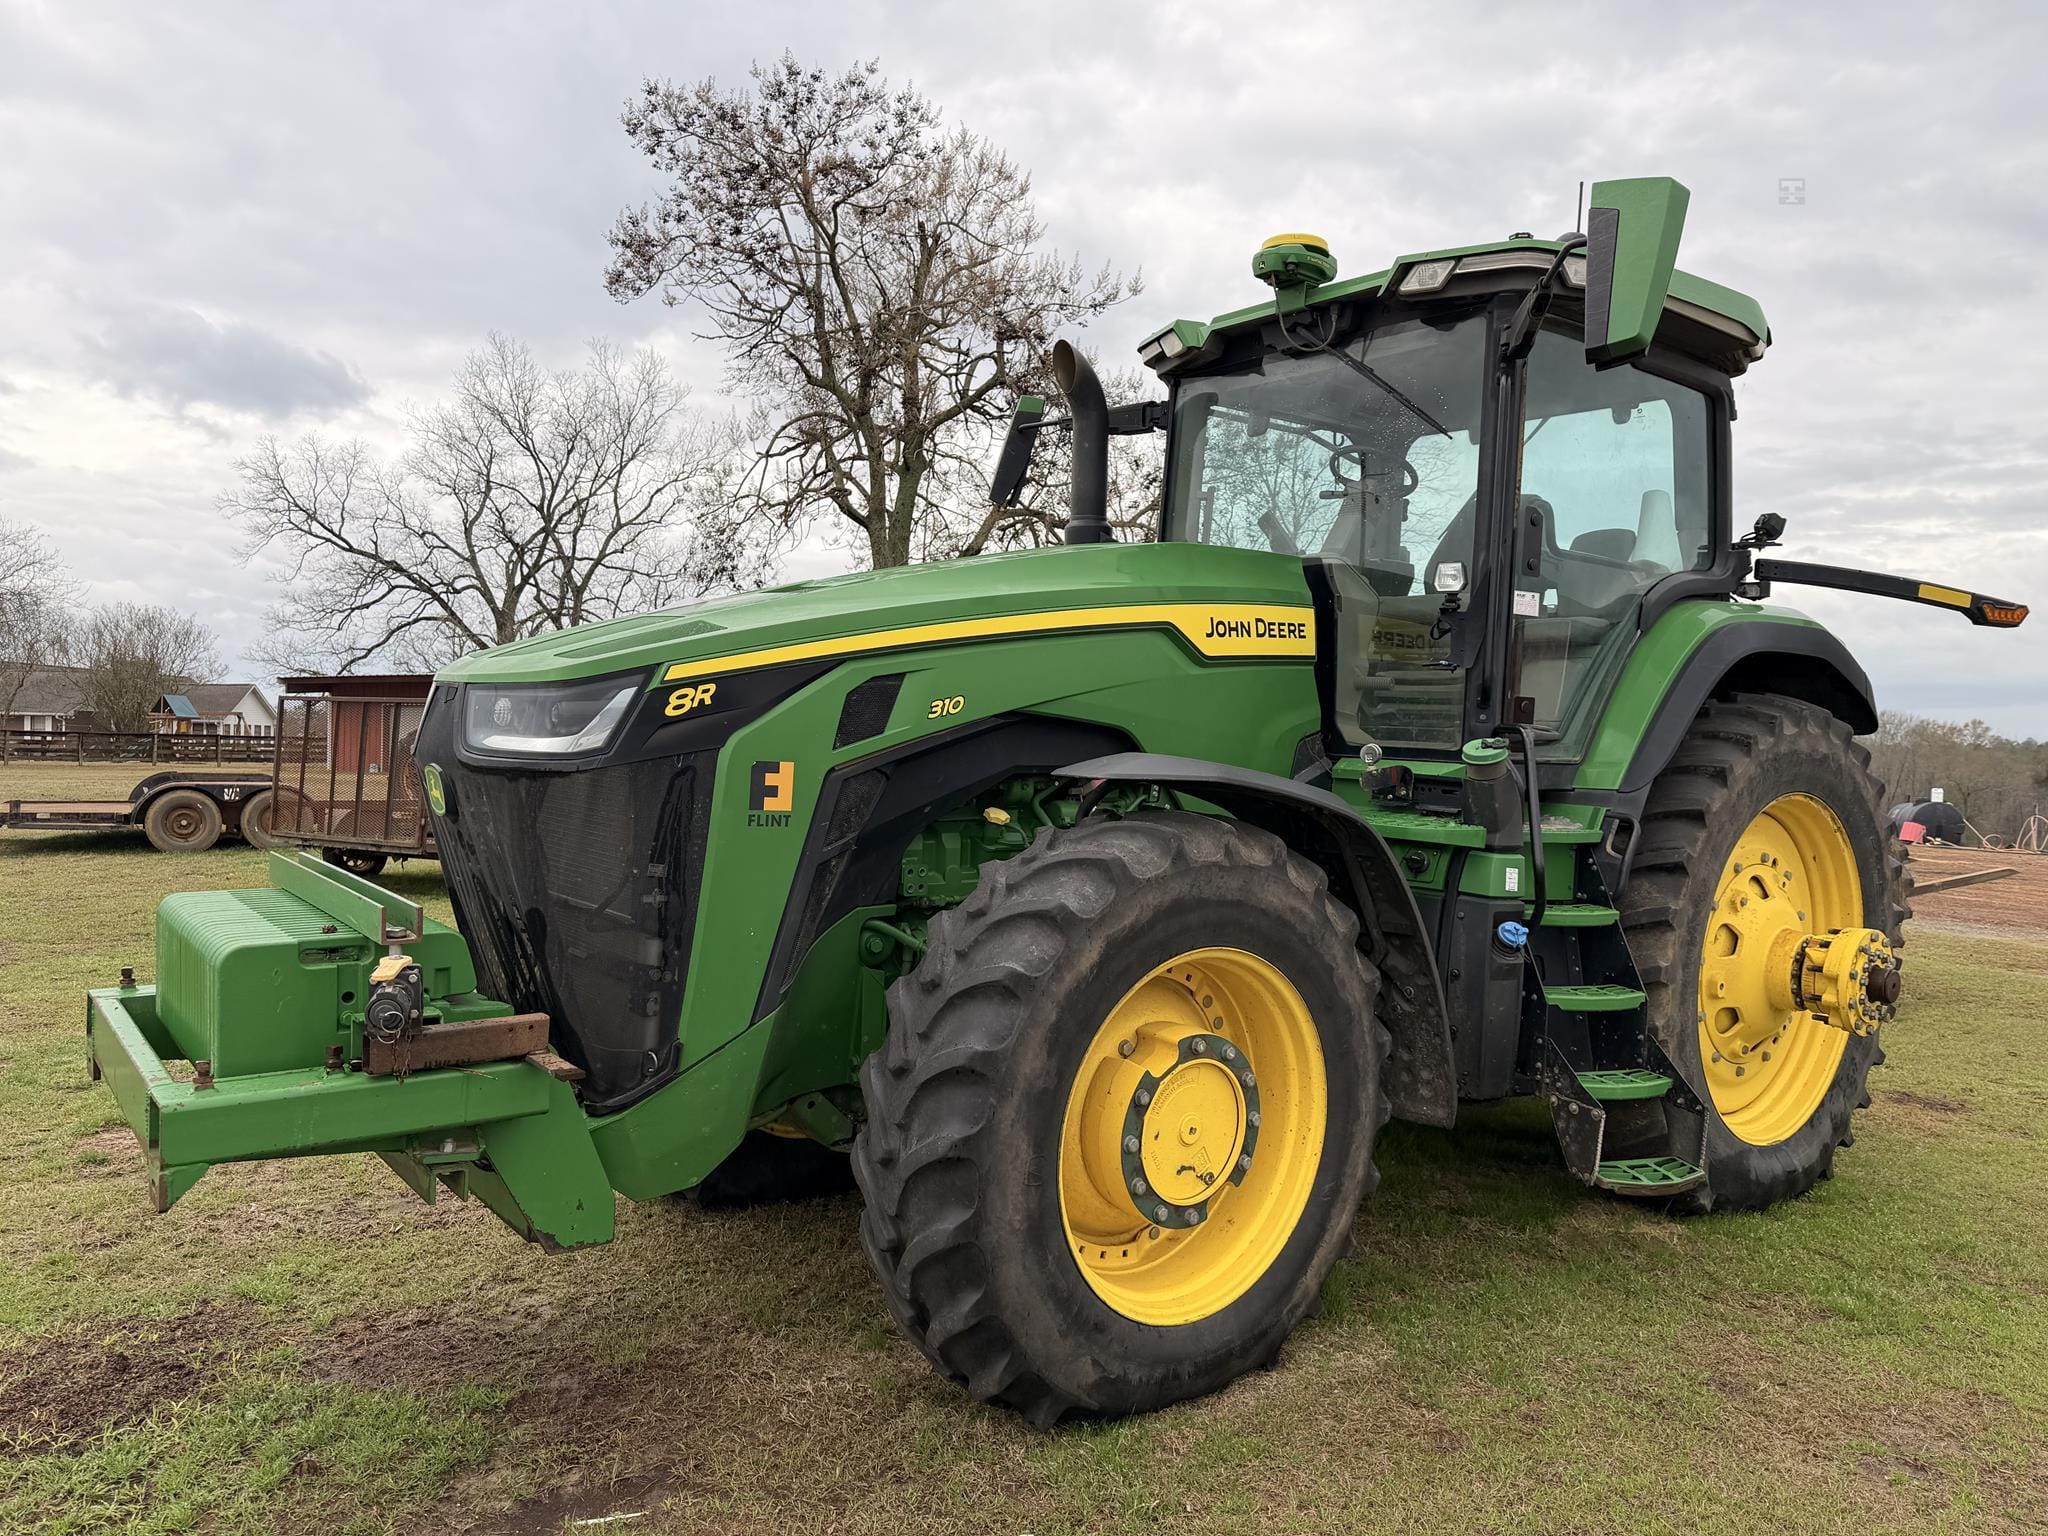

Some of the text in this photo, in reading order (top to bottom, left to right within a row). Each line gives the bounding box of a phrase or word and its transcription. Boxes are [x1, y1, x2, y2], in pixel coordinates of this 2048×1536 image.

[1206, 616, 1307, 639] JOHN DEERE
[664, 683, 717, 717] 8R
[928, 695, 965, 719] 310
[747, 814, 792, 827] FLINT
